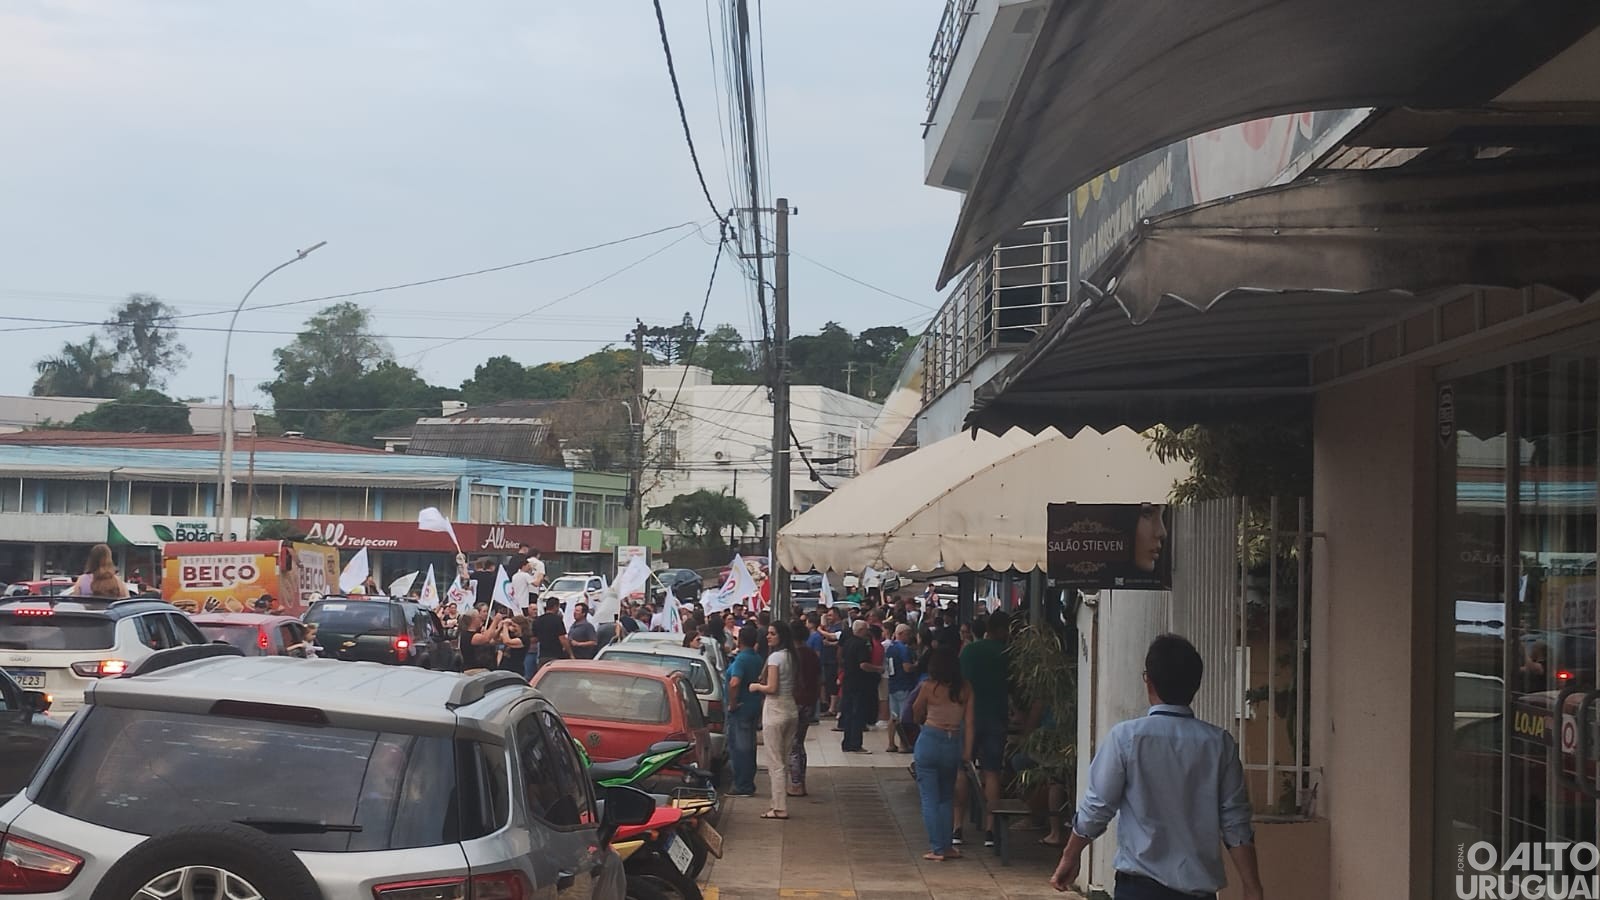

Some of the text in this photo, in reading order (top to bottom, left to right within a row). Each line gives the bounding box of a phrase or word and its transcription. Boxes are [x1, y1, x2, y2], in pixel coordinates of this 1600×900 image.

[304, 523, 398, 547] All Telecom
[482, 526, 505, 549] All
[1048, 539, 1124, 551] SALÃO STIEVEN
[183, 565, 256, 586] BEIÇO
